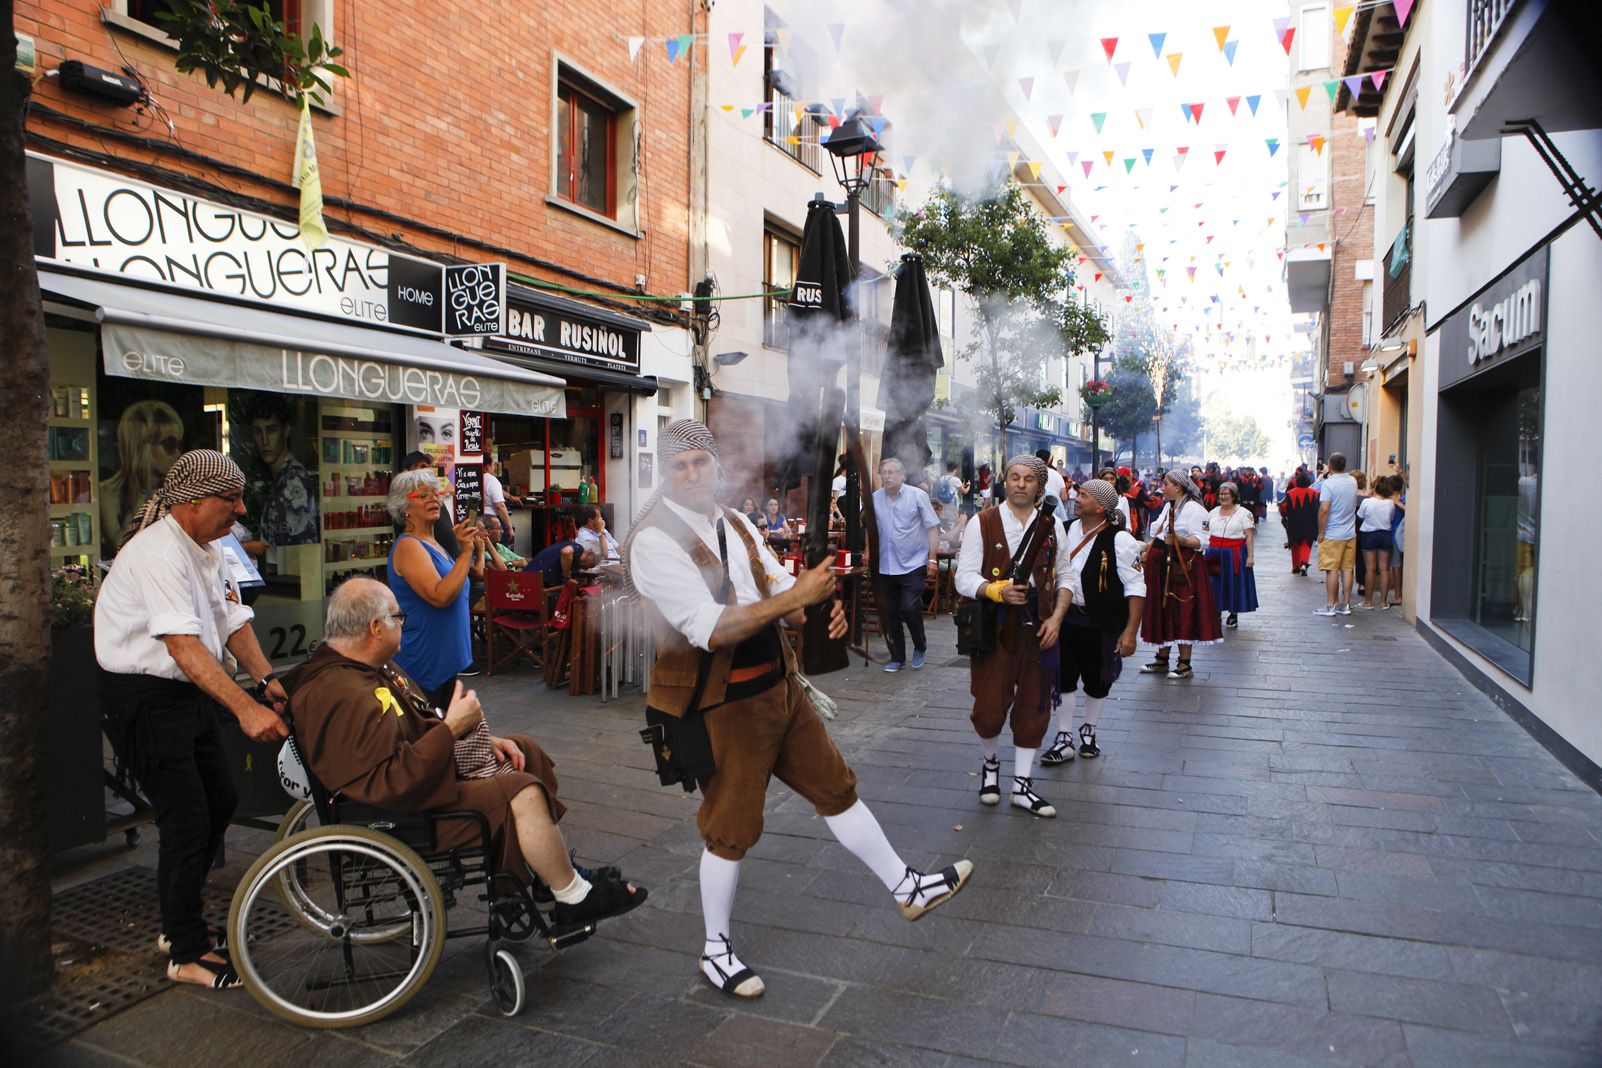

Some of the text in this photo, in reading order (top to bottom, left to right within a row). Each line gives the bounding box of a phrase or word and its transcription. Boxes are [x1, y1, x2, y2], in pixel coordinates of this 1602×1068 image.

[508, 308, 627, 358] BAR RUSIÑOL
[1467, 278, 1542, 366] Sacum
[282, 349, 481, 408] LLONGUERAS
